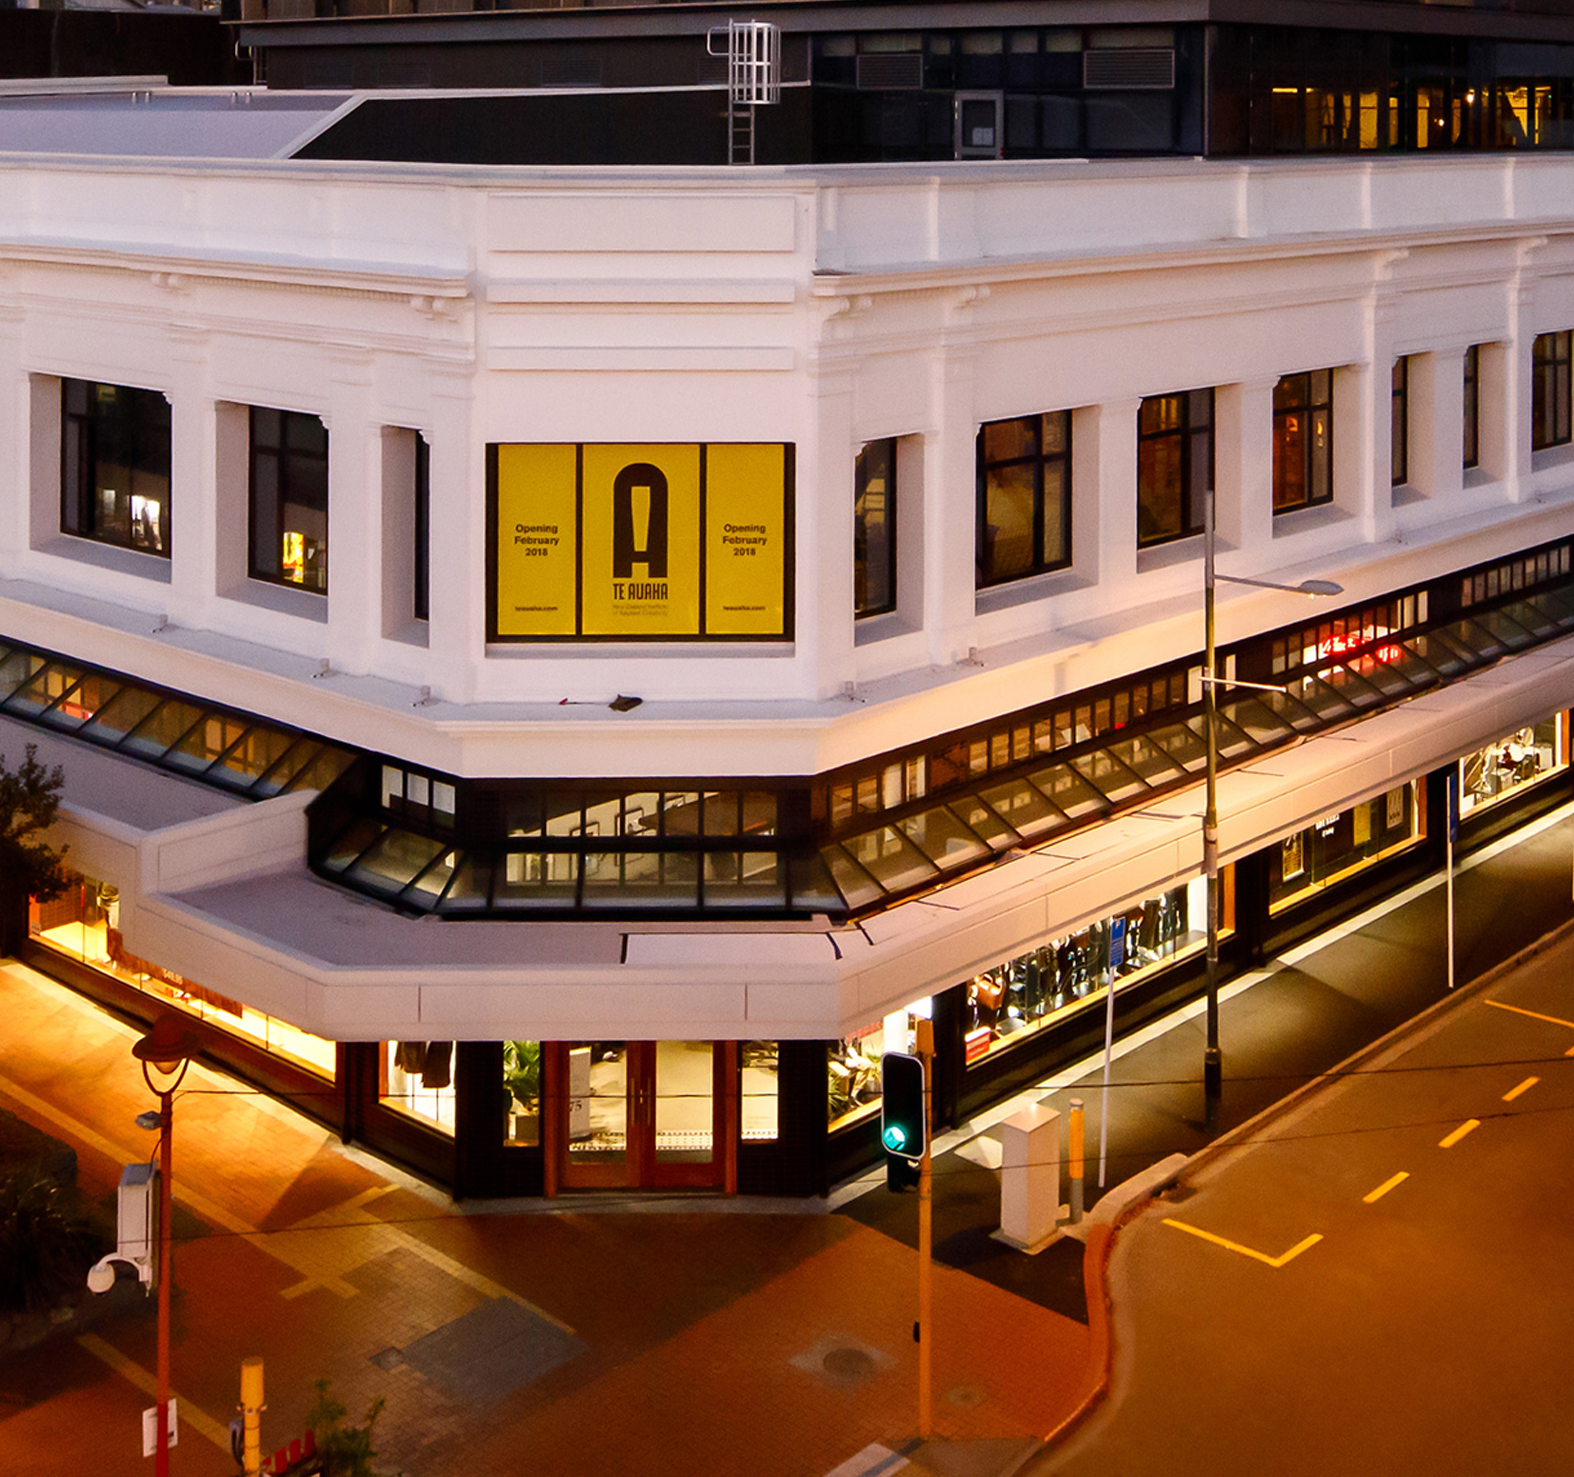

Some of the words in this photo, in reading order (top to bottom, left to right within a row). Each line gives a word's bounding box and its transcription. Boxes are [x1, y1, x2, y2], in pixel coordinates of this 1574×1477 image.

[613, 462, 668, 578] A
[515, 524, 558, 534] Opening
[723, 524, 766, 534] Opening
[514, 536, 559, 546] February
[722, 536, 767, 546] February
[525, 548, 549, 556] 2018
[733, 548, 756, 556] 2018
[613, 583, 625, 600] TE
[628, 583, 668, 600] AUAHA
